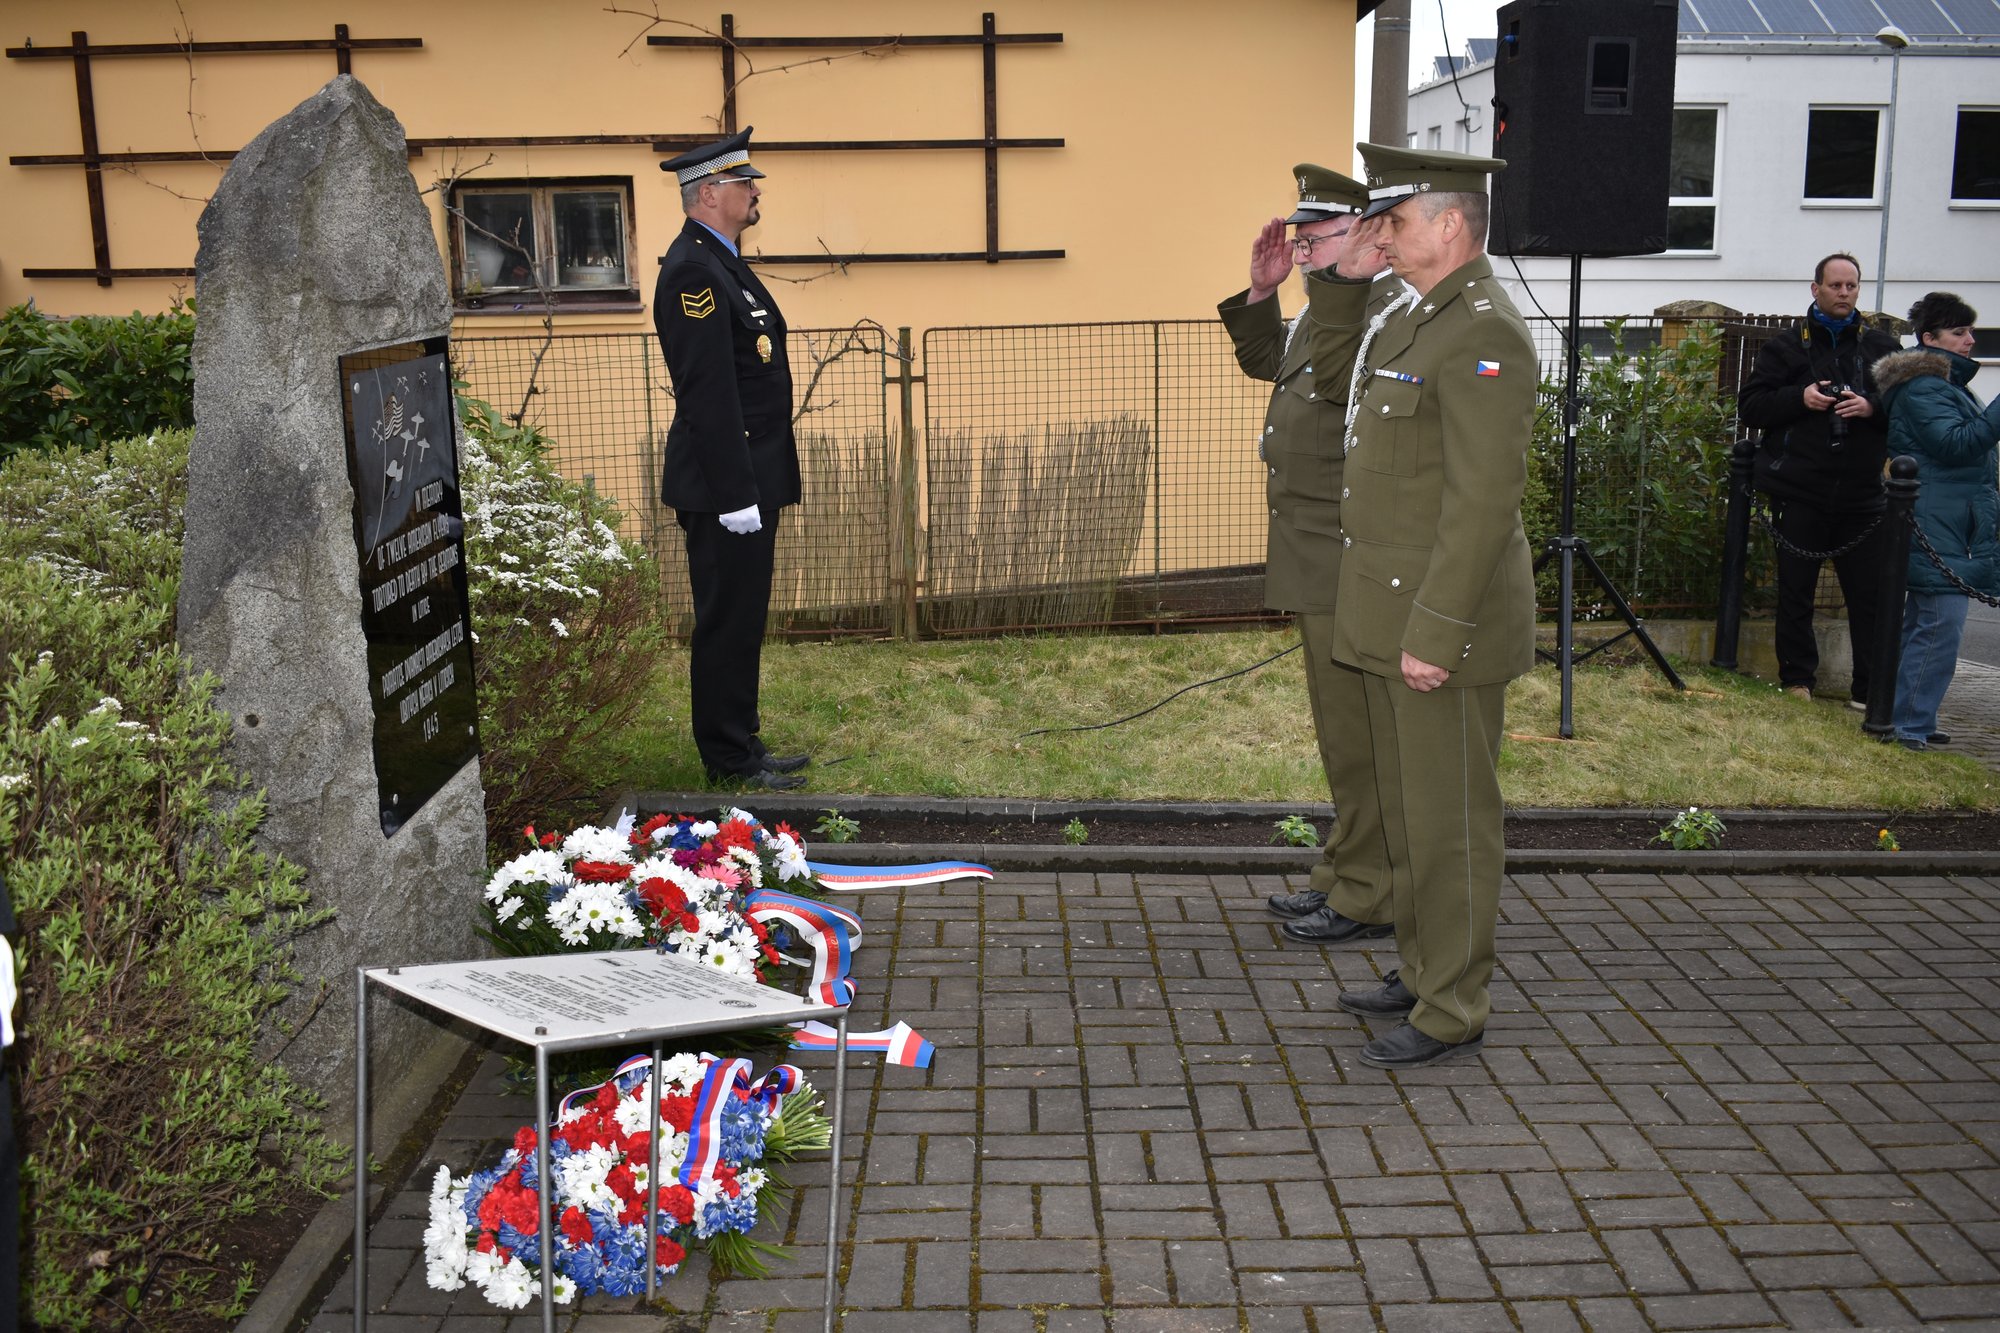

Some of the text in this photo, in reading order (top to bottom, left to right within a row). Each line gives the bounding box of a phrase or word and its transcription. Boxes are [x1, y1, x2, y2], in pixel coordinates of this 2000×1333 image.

[386, 534, 407, 566] TWELVE
[407, 521, 432, 554] AMERICAN
[405, 564, 421, 594] DEATH
[428, 555, 437, 580] THE
[423, 711, 439, 743] 1945
